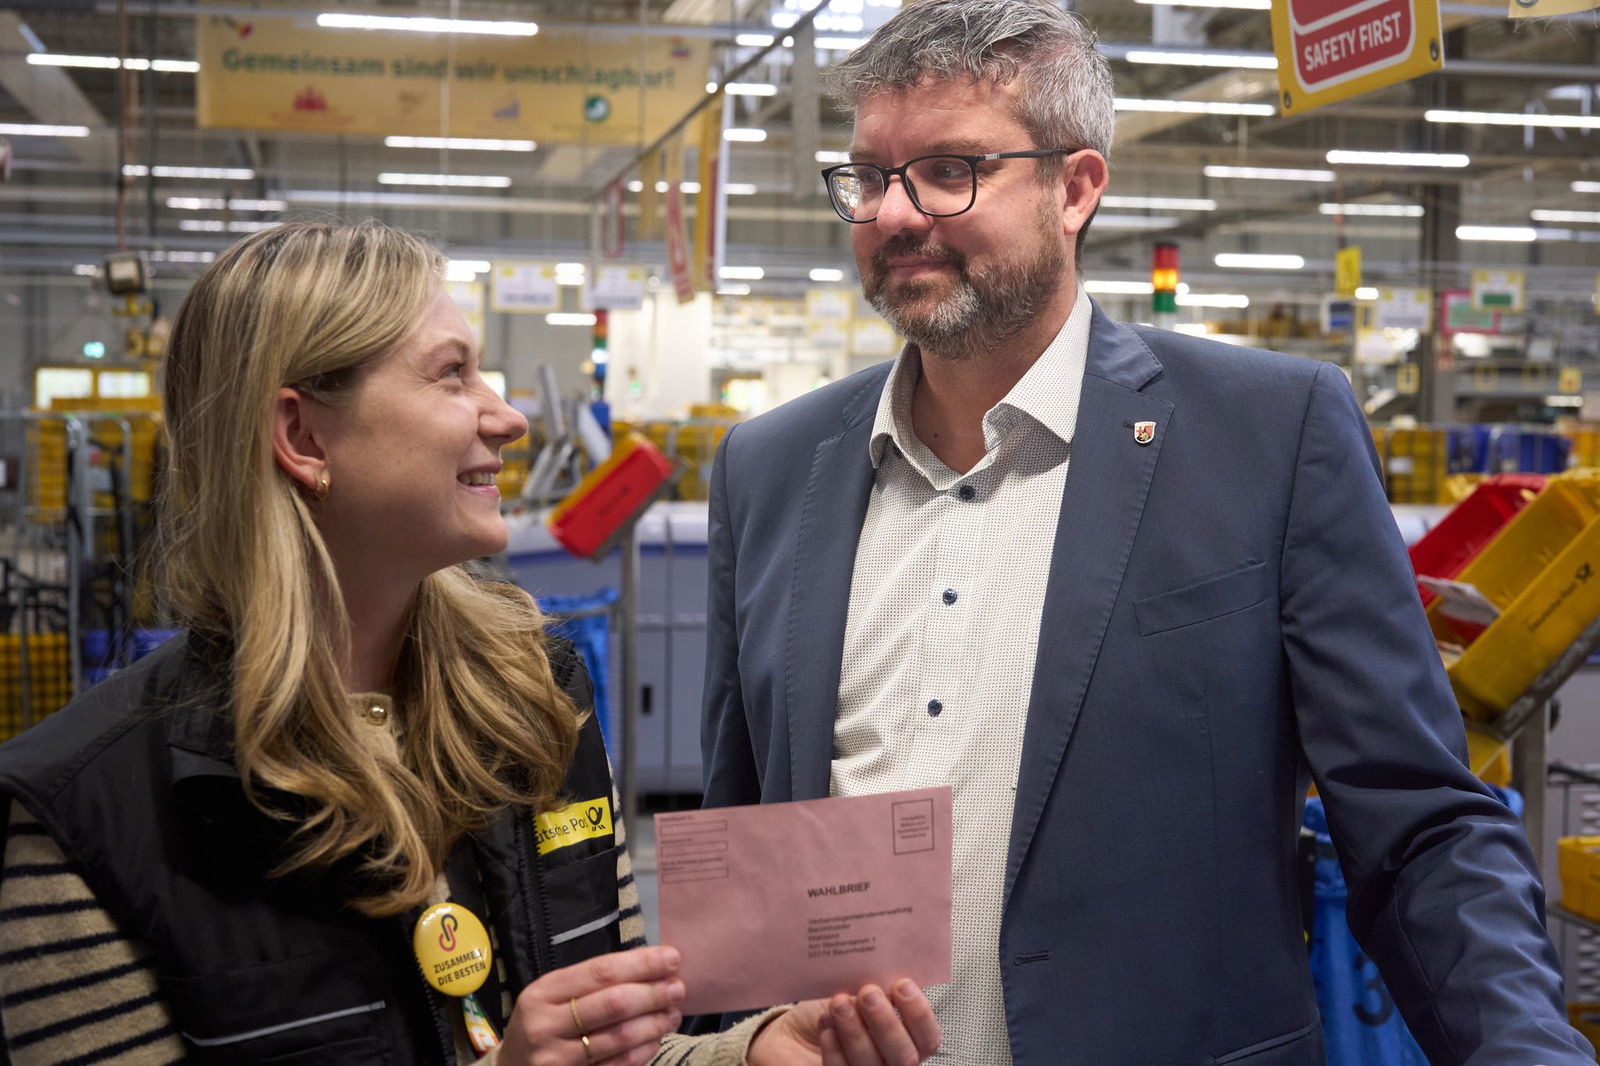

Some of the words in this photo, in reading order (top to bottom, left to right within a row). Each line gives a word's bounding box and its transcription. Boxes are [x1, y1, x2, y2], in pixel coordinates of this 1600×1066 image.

[1304, 29, 1356, 71] SAFETY
[1359, 12, 1401, 51] FIRST
[222, 48, 385, 75] Gemeinsam
[392, 54, 448, 79] sind
[455, 56, 496, 81] wir
[807, 881, 871, 898] WAHLBRIEF
[438, 971, 454, 987] DIE
[454, 961, 487, 980] BESTEN
